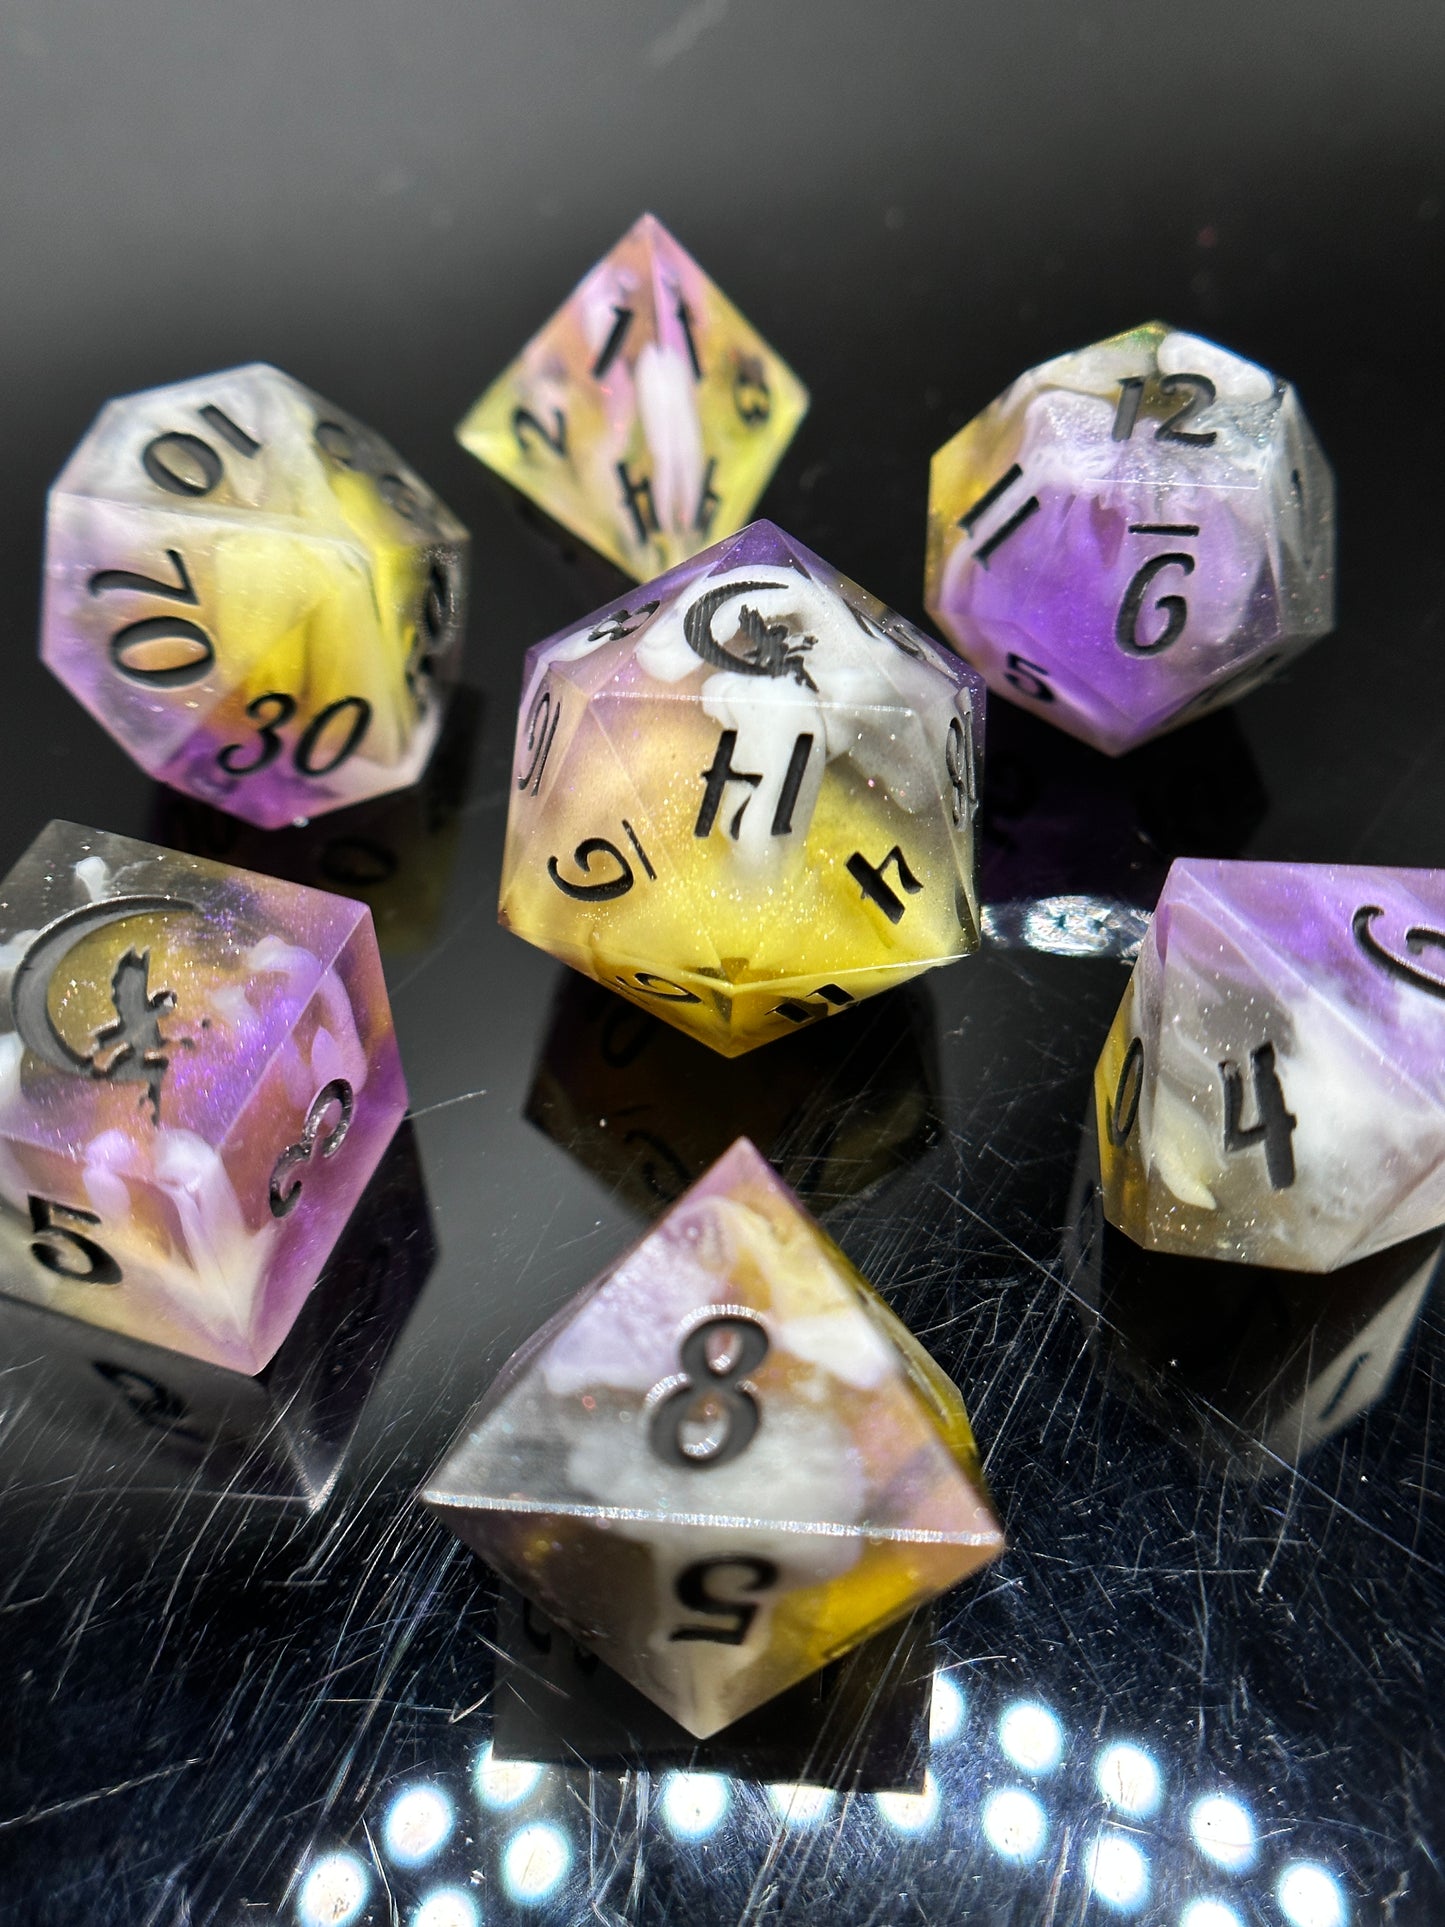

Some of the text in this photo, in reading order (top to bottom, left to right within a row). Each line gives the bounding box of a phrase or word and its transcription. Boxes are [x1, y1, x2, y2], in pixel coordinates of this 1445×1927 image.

[1111, 373, 1217, 448] 12
[958, 463, 1040, 570] 11
[88, 549, 216, 689] 70
[1003, 652, 1055, 703] 5
[217, 692, 373, 778] 30
[268, 1078, 355, 1218] 3
[1217, 1041, 1296, 1190] 4
[28, 1194, 123, 1285] 5
[647, 1308, 770, 1469] 8
